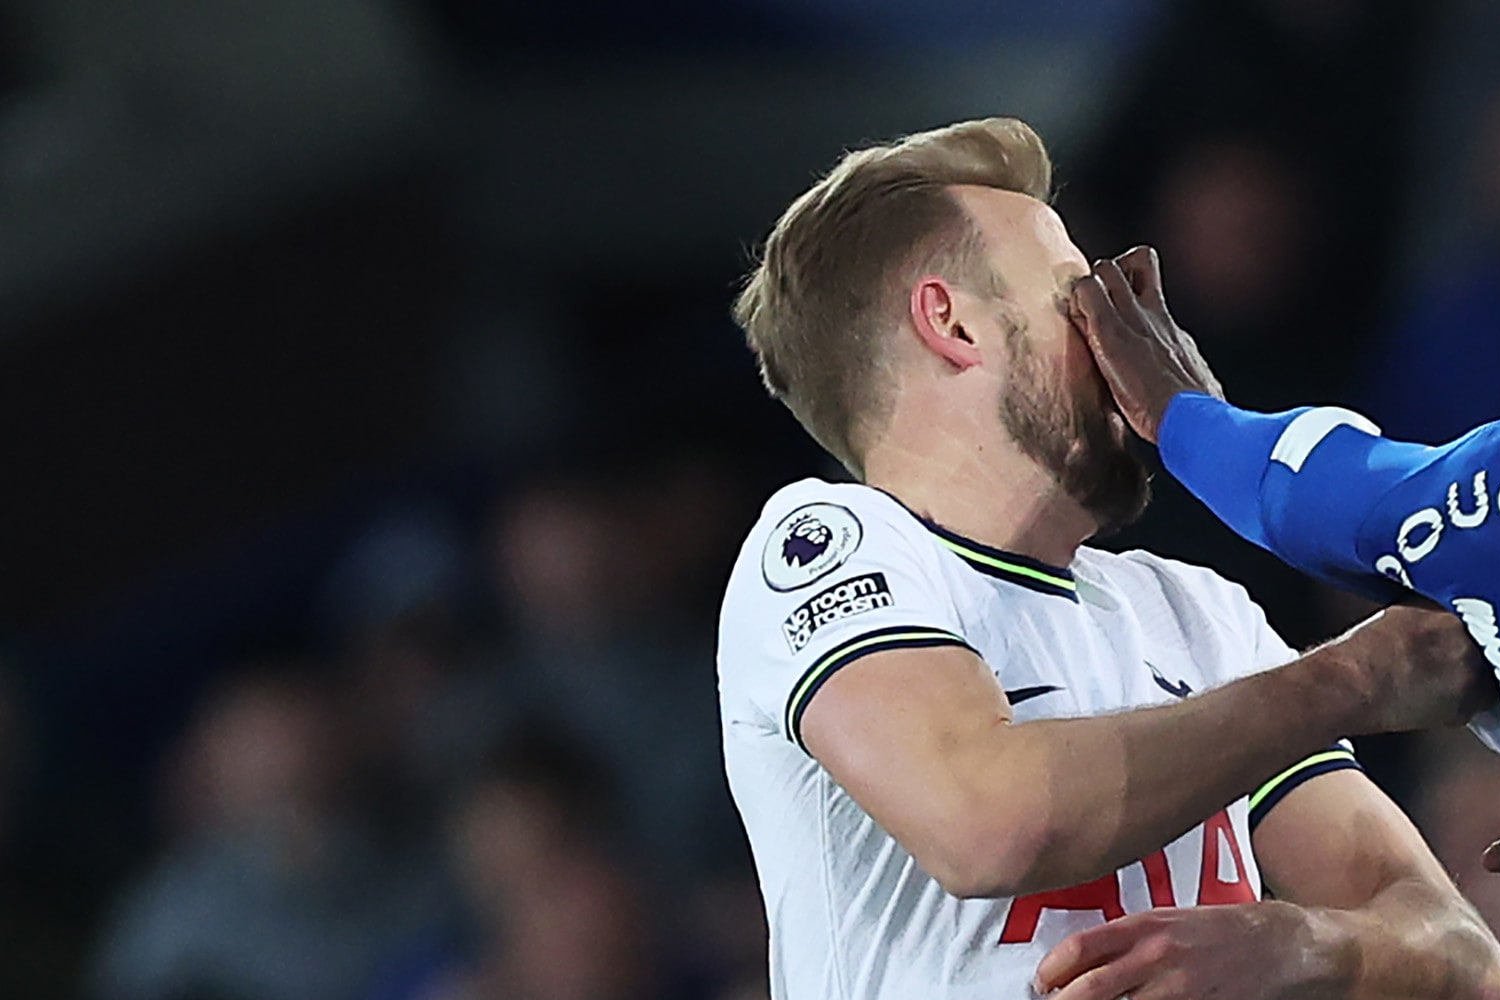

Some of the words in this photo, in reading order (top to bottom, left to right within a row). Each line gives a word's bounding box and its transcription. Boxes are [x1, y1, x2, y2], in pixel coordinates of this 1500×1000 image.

[783, 608, 809, 640] No
[810, 578, 877, 614] room
[813, 591, 893, 628] racism
